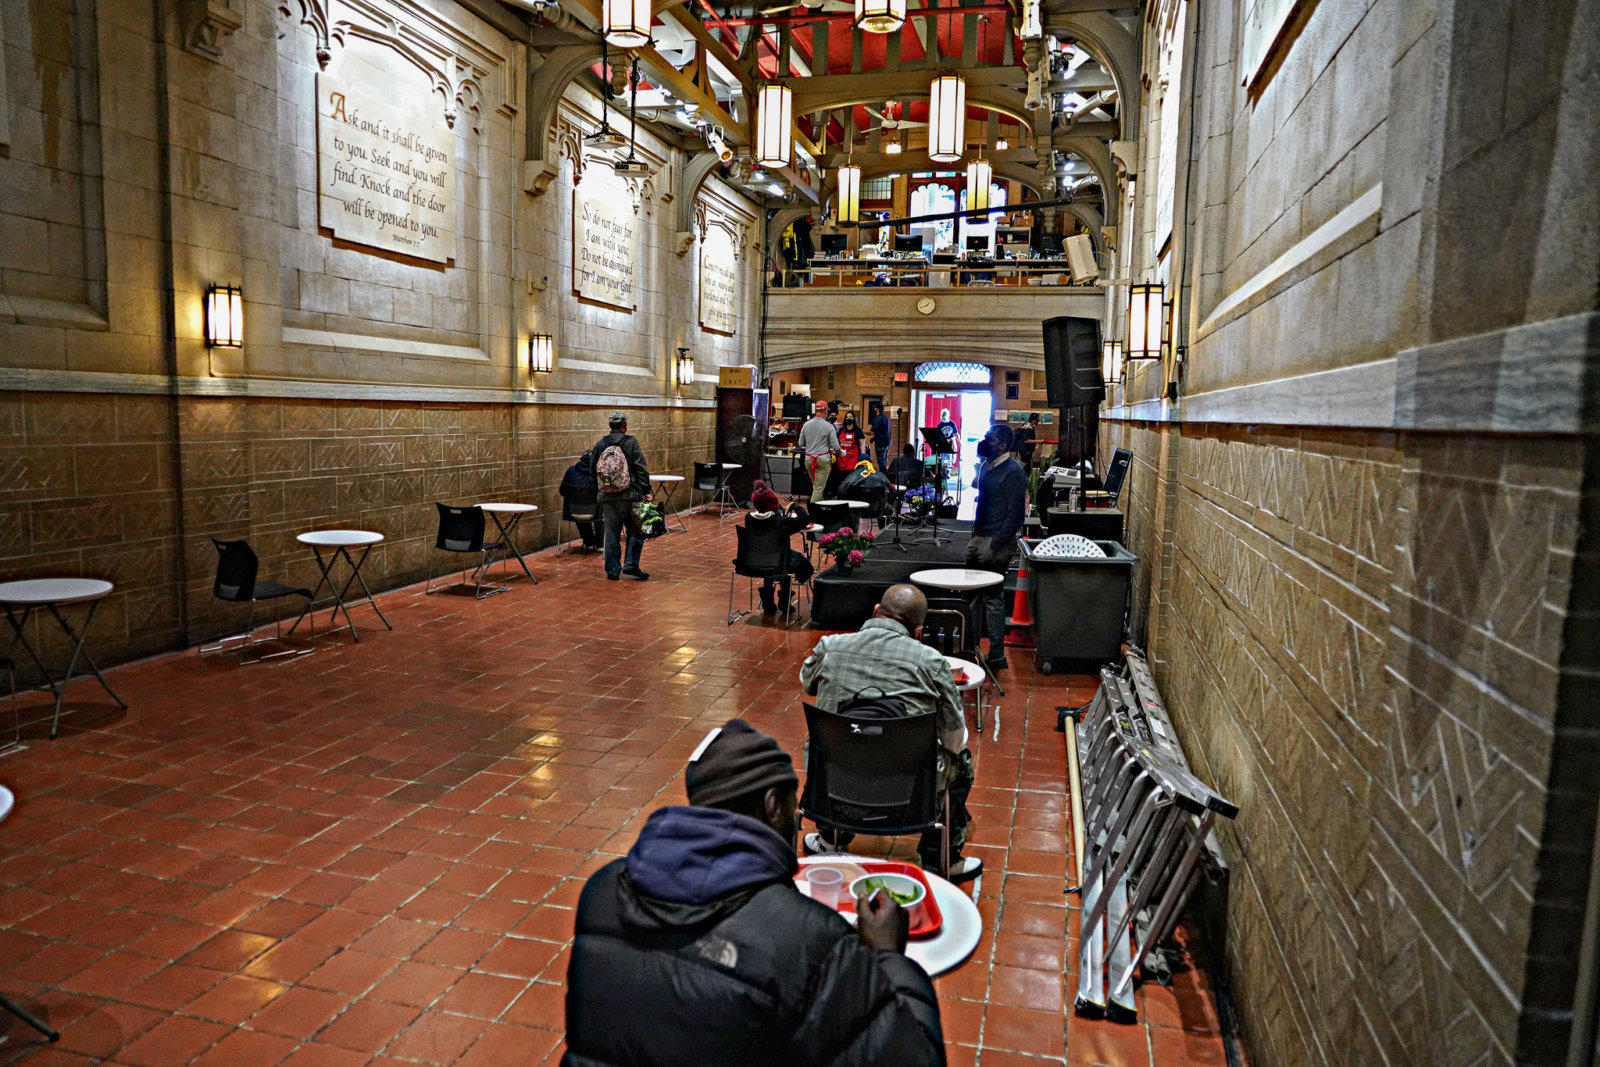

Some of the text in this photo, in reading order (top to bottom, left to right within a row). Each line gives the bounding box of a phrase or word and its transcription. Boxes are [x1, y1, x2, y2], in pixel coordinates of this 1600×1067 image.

[330, 92, 448, 164] Ask and it shall be given
[330, 161, 446, 213] find. Knock and the door
[334, 136, 447, 188] to you. Seek and you will
[343, 197, 439, 241] will be opened to you.
[581, 247, 591, 262] Do
